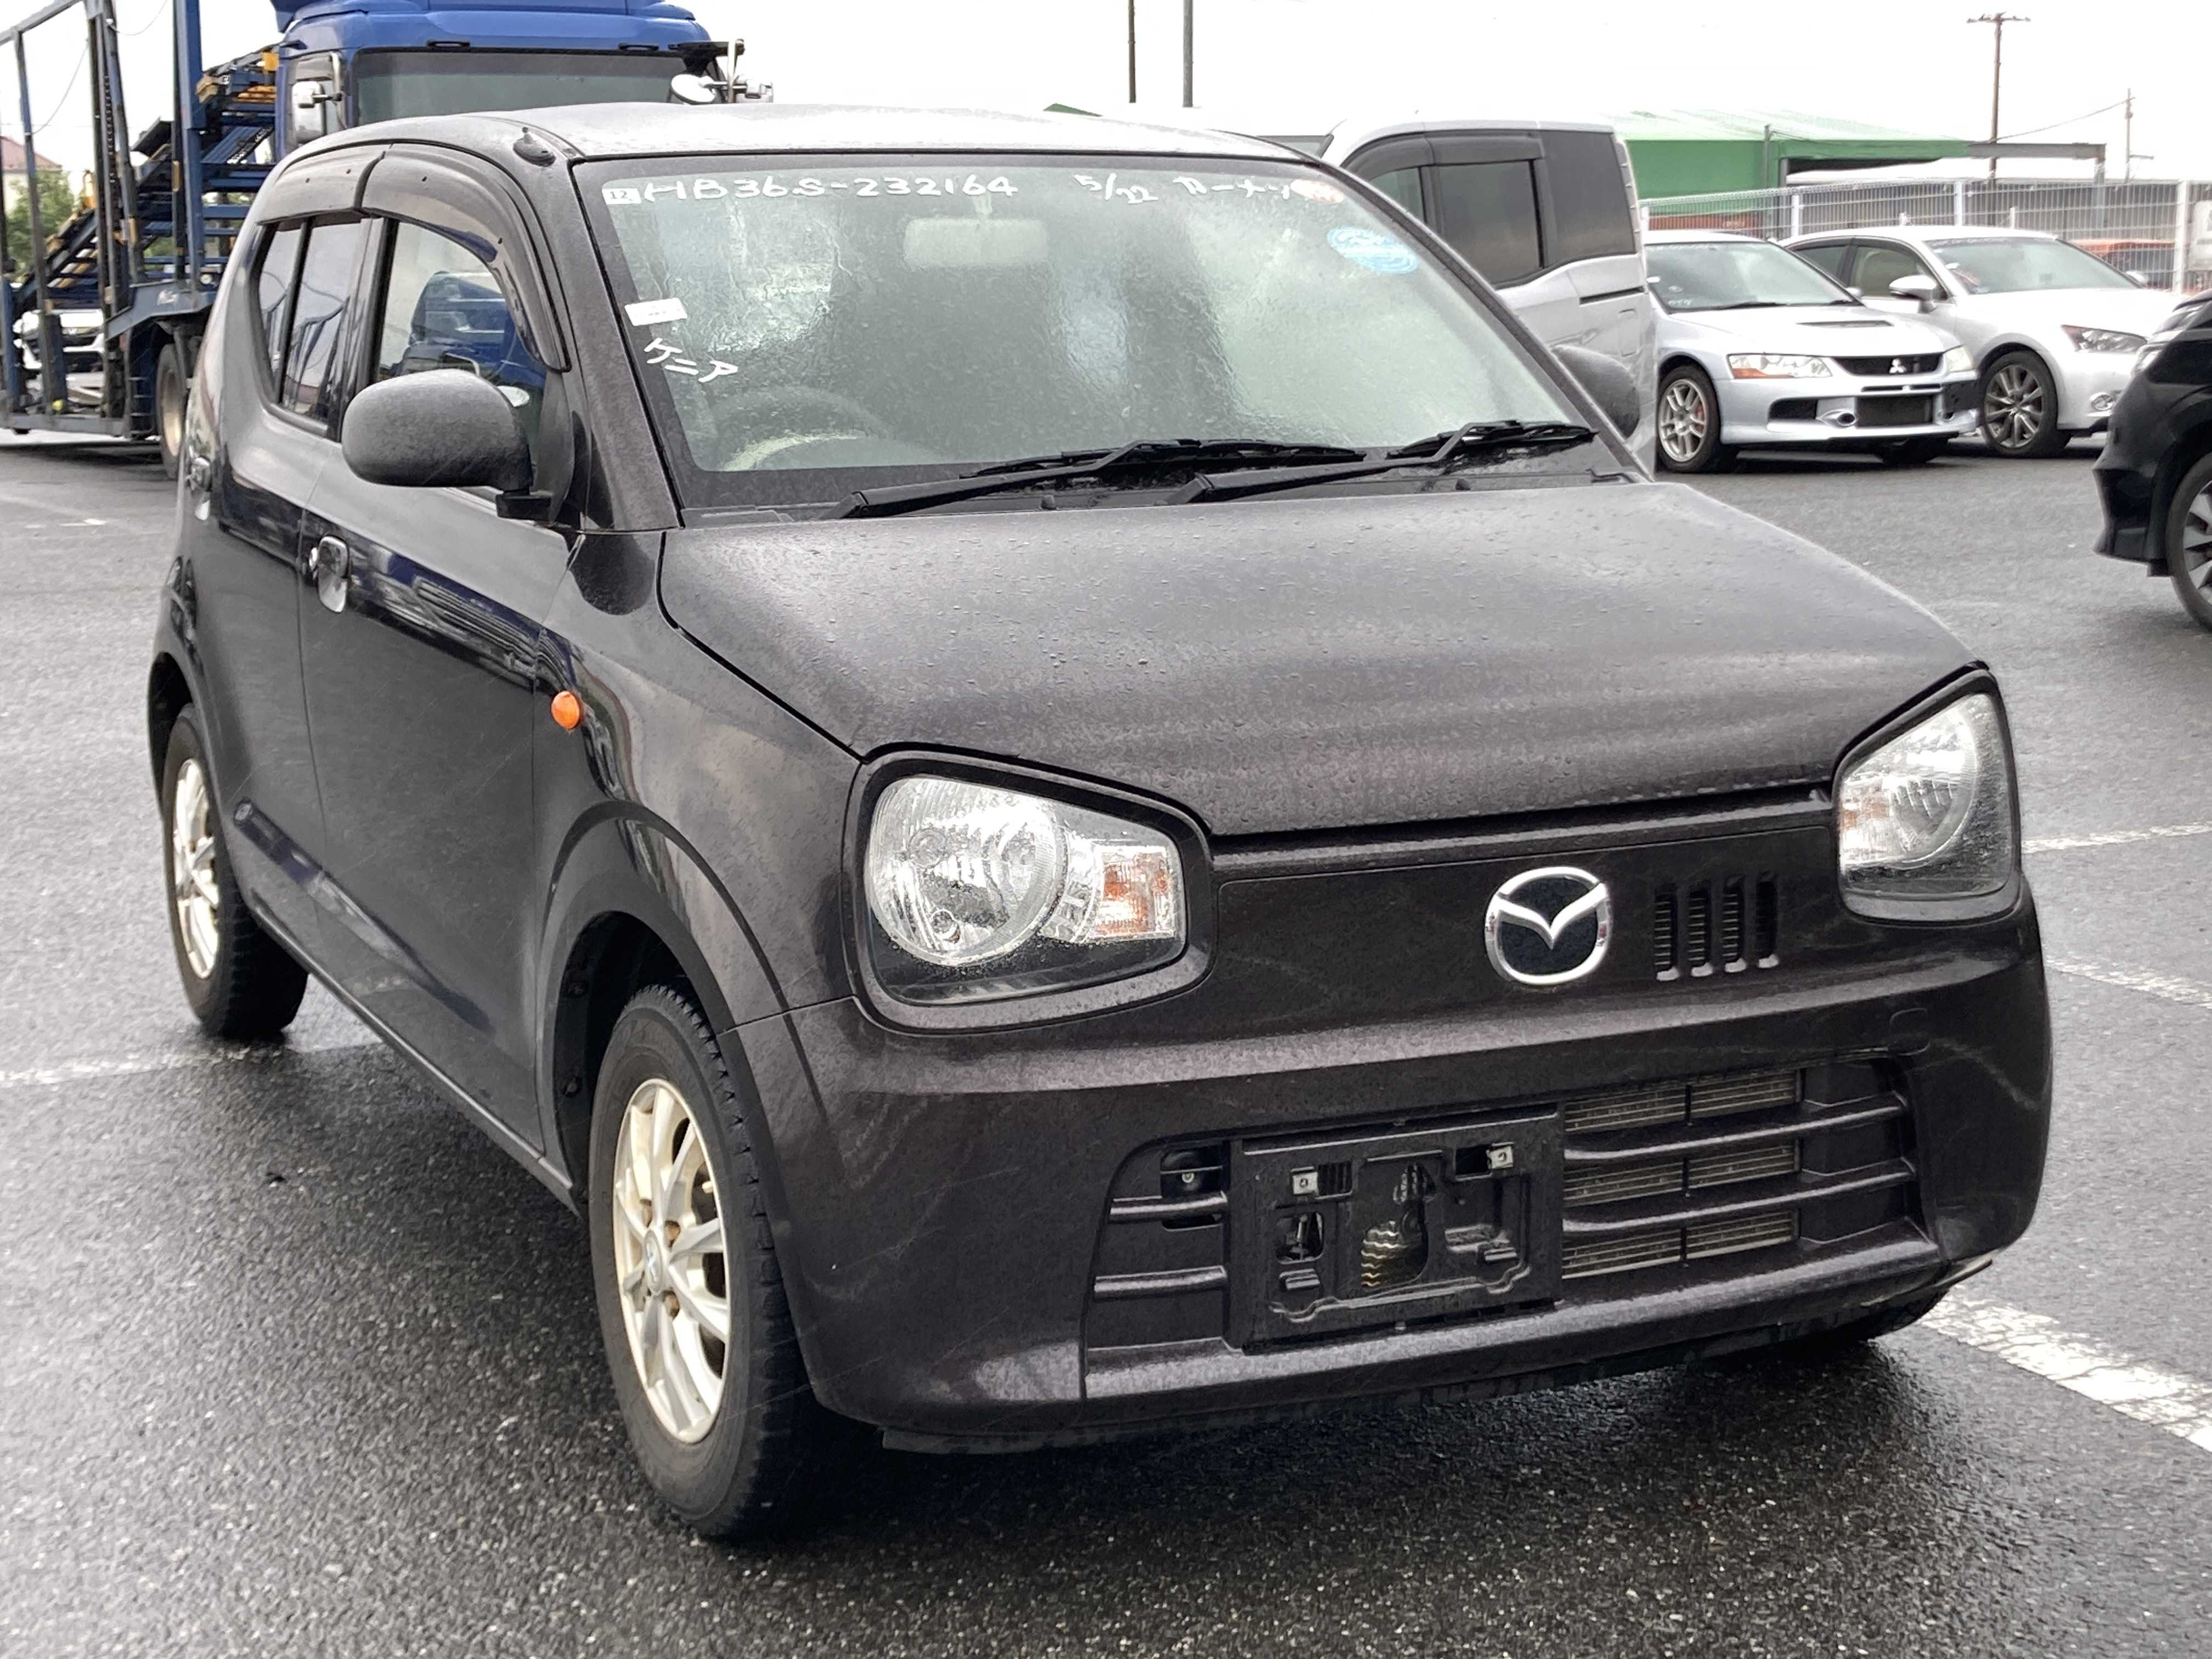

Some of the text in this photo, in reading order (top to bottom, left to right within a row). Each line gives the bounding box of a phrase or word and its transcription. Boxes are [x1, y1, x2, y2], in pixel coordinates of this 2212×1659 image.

[610, 190, 628, 199] 12
[644, 173, 1159, 204] HB36S-232164 5/22
